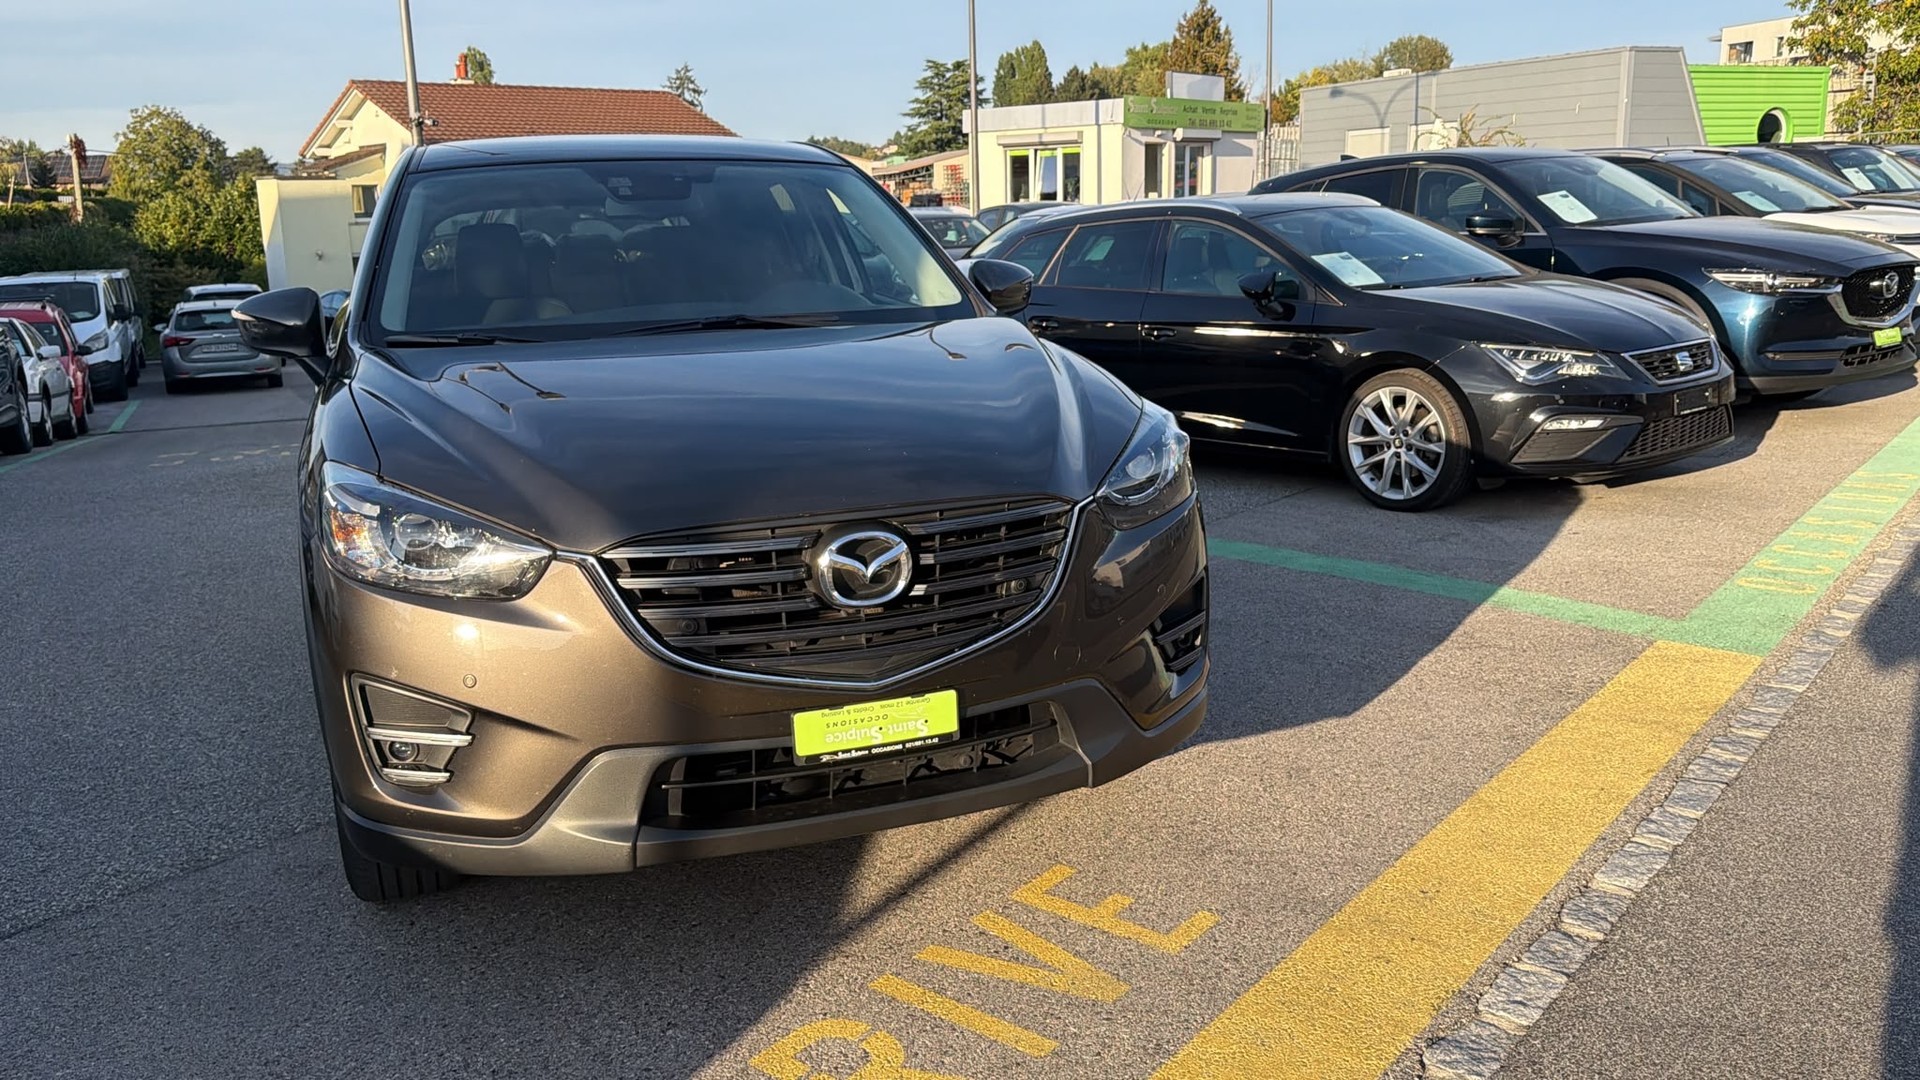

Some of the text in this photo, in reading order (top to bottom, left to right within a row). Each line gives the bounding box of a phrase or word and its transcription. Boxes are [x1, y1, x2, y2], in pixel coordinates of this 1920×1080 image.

[905, 697, 931, 705] Garantie
[821, 710, 845, 718] Leasing
[825, 713, 889, 729] OCCASIONS
[871, 744, 903, 754] OCCASIONS
